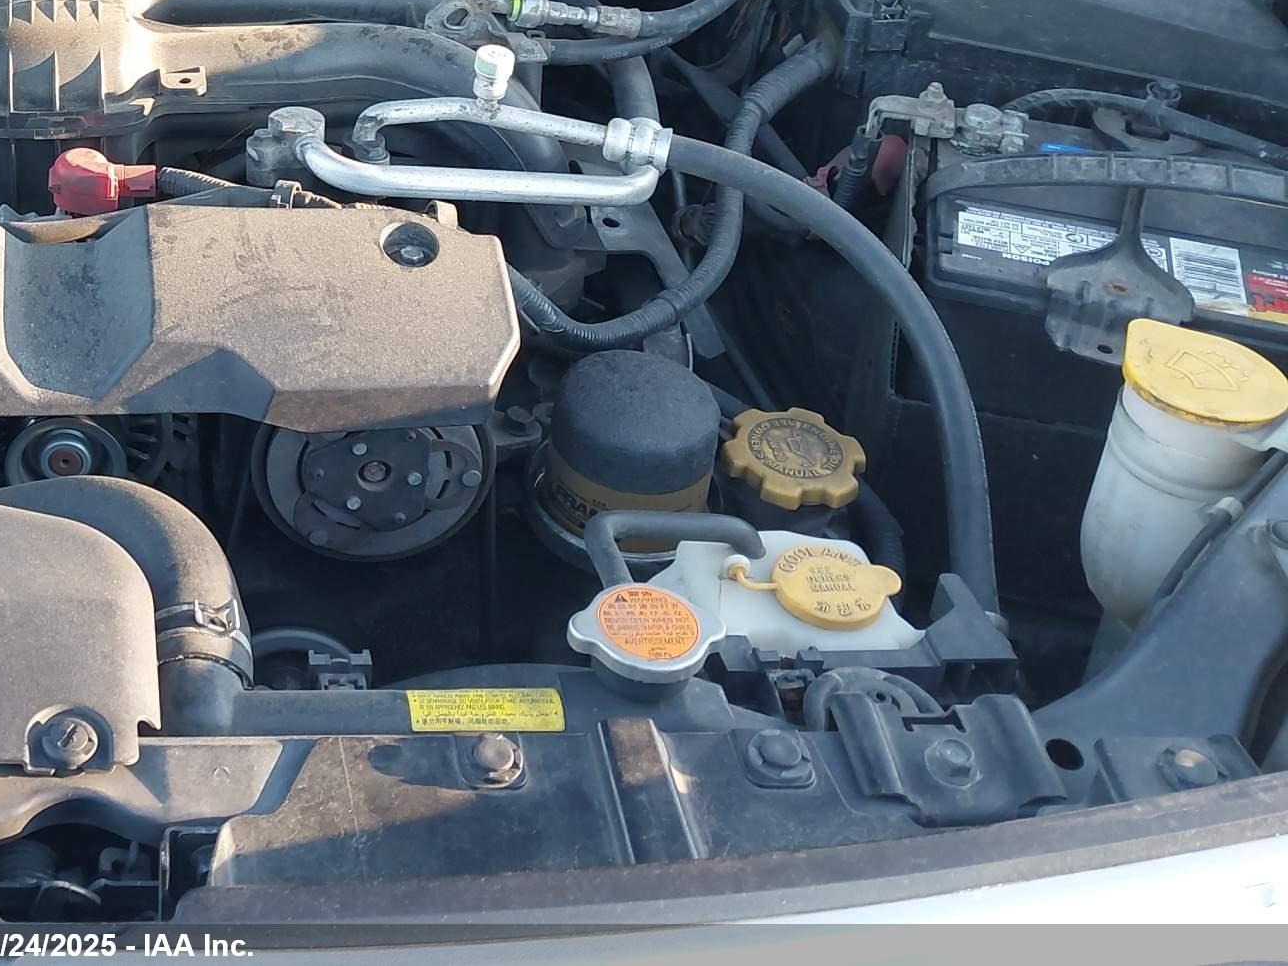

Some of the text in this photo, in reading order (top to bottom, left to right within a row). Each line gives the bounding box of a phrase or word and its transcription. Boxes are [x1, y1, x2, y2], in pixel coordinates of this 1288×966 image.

[1002, 253, 1051, 266] POISON
[762, 458, 824, 478] MANUAL
[778, 546, 863, 573] COOLANT
[624, 637, 686, 645] AVERTISSEMENT
